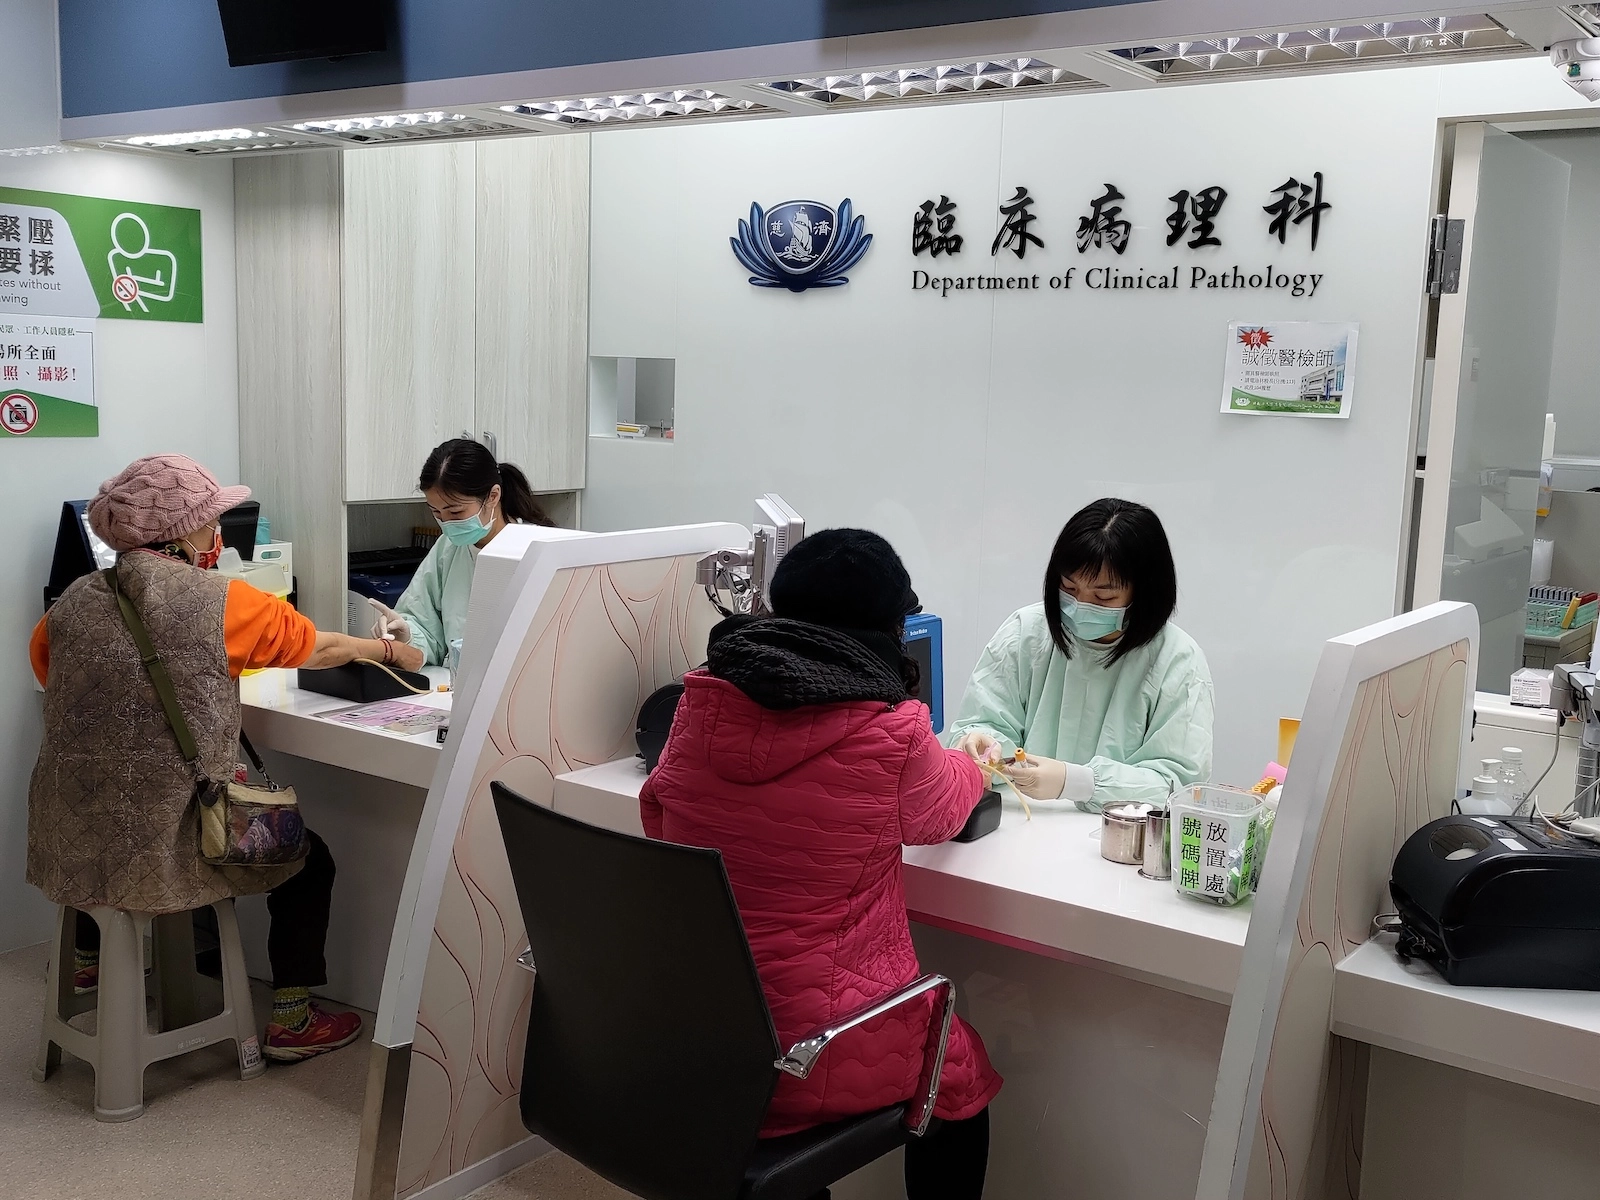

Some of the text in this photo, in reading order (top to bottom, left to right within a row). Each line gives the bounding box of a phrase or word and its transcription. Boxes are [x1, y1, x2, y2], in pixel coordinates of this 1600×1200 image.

[0, 214, 54, 245] 緊壓
[912, 171, 1332, 259] 臨床病理科
[0, 247, 55, 276] 要揉
[19, 278, 61, 291] without
[911, 265, 1324, 298] Department of Clinical Pathology
[0, 293, 29, 307] wing
[1241, 348, 1335, 367] 誠徵醫檢師
[1180, 816, 1201, 889] 號碼牌
[1204, 822, 1228, 894] 放置處
